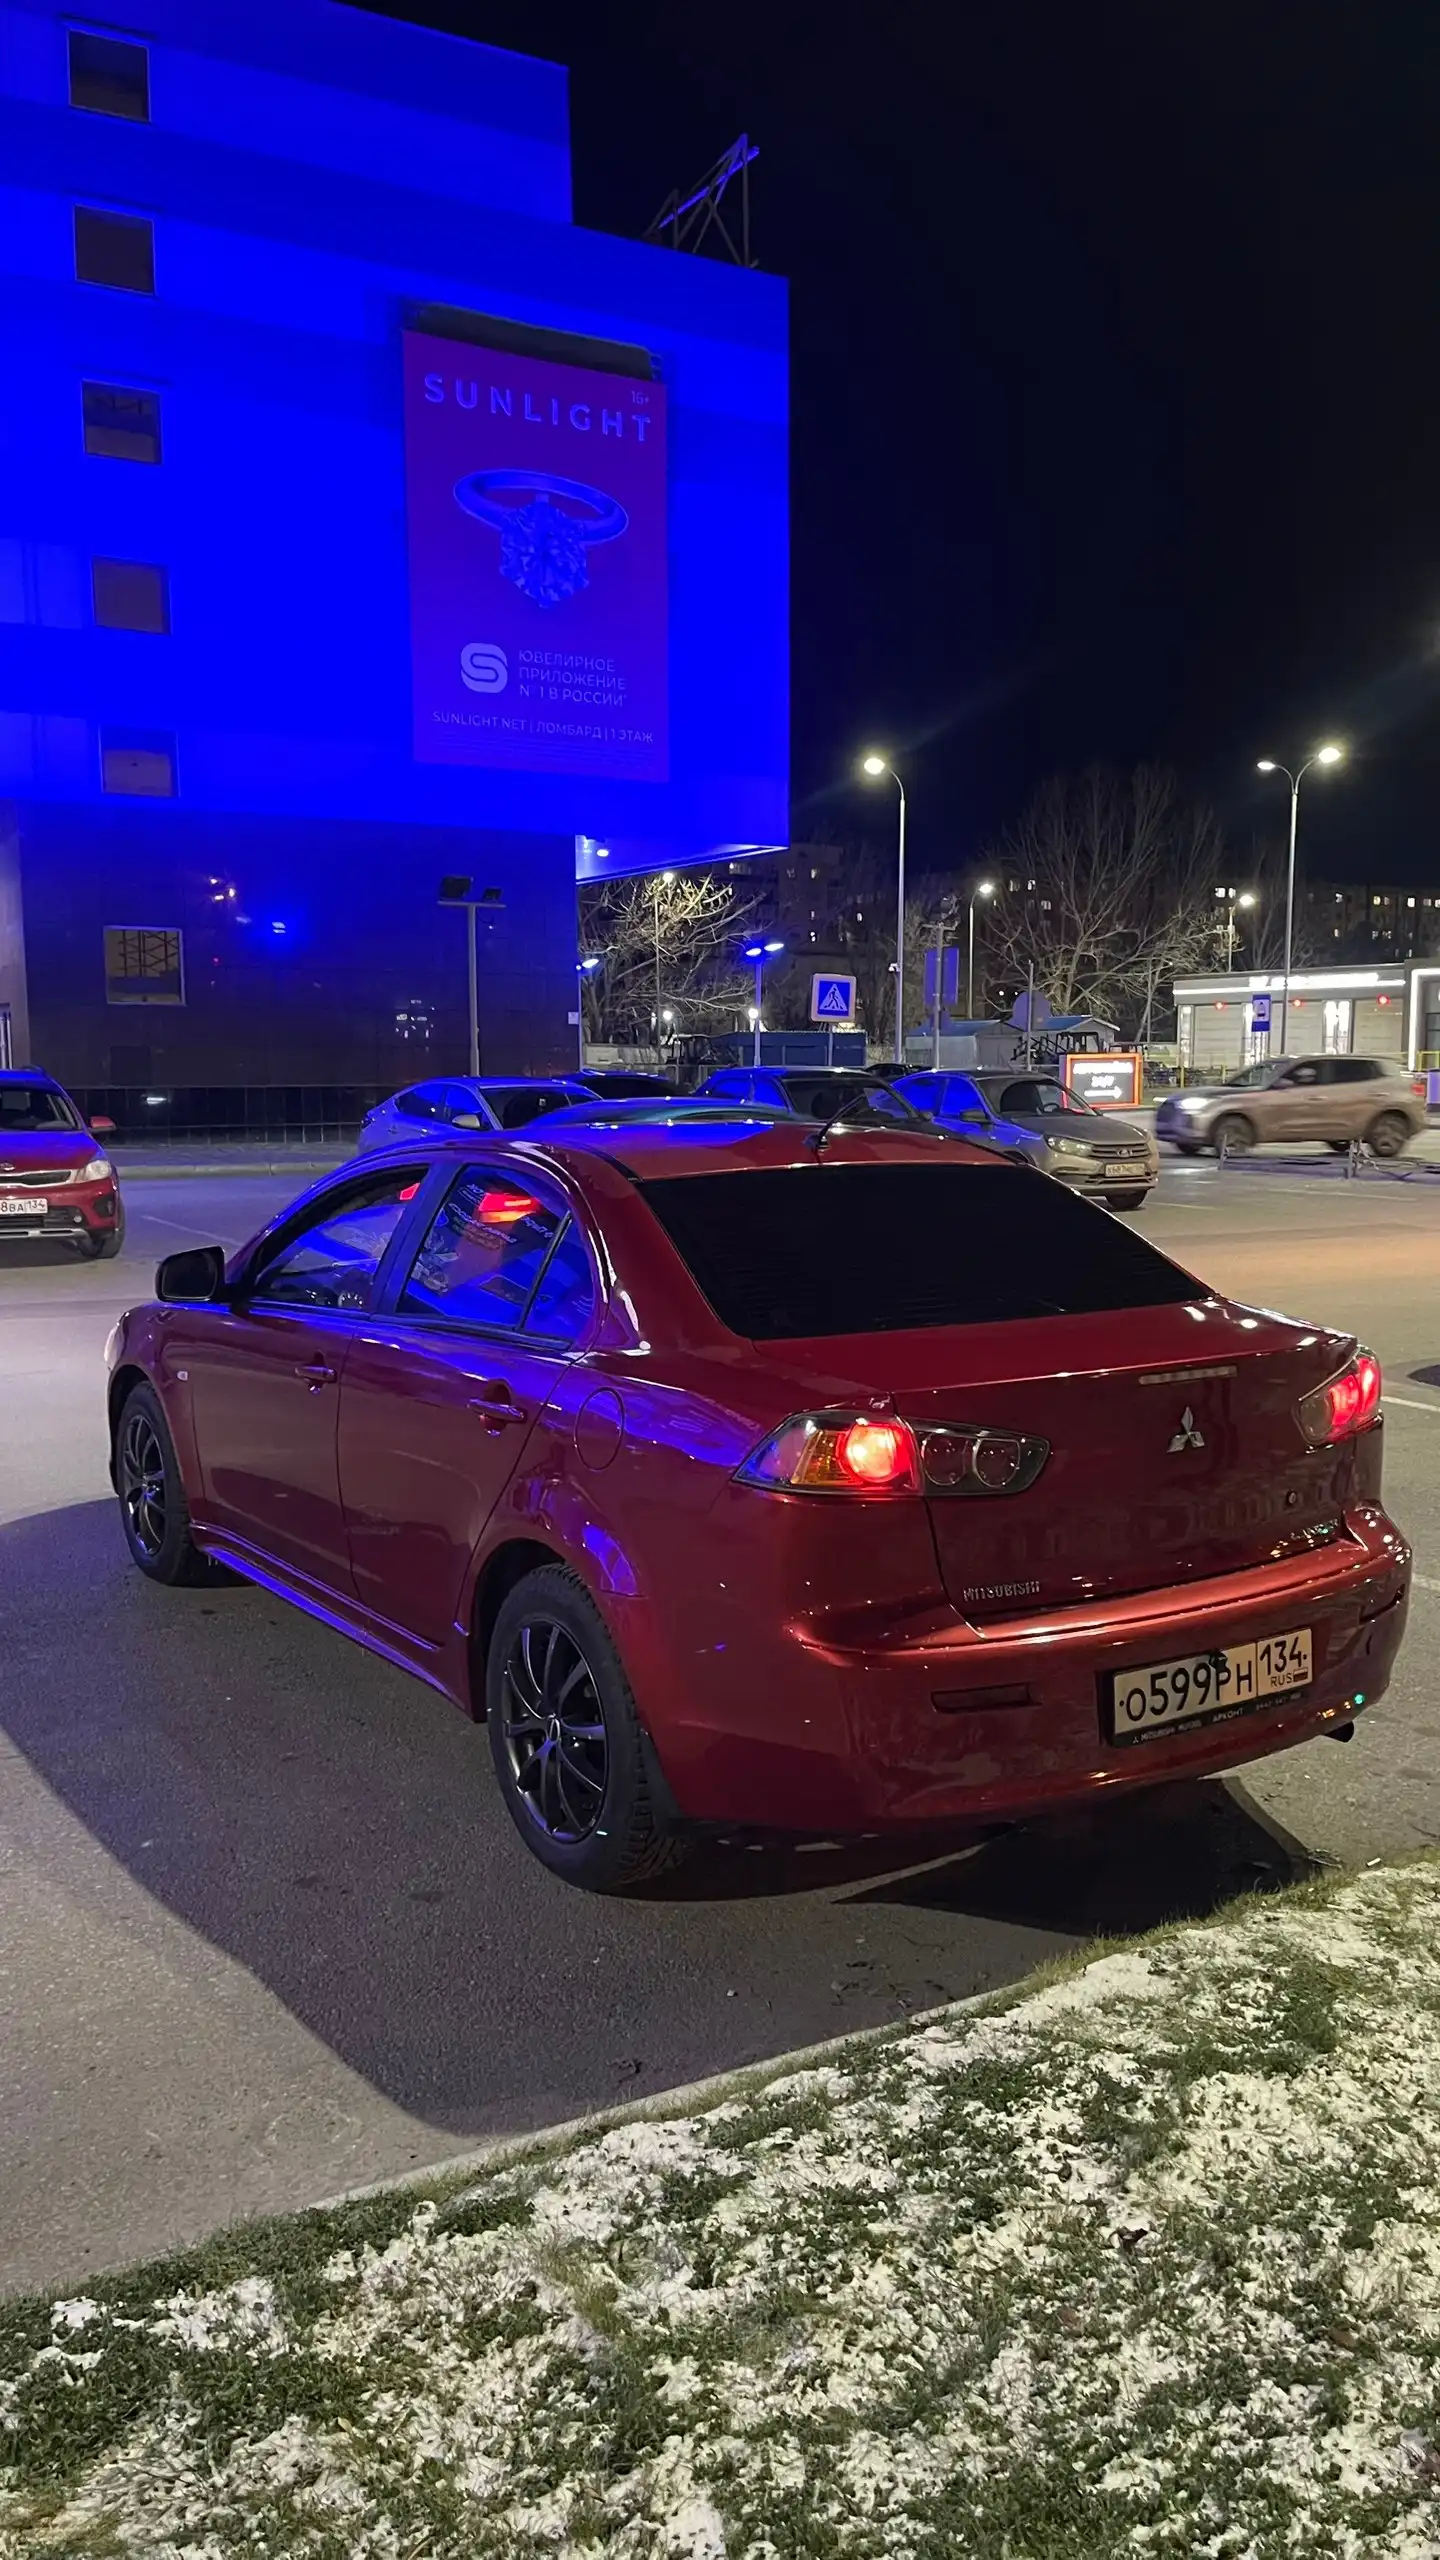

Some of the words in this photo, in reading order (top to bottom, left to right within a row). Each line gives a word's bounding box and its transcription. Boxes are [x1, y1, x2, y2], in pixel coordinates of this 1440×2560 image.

[424, 372, 651, 442] SUNLIGHT
[518, 649, 616, 673] ЮВЕЛИРНОЕ
[518, 667, 627, 690] ПРИЛОЖЕНИЕ
[536, 721, 602, 739] ЛОМБАРД
[618, 729, 654, 744] ЭТАЖ
[963, 1580, 1040, 1602] MITSUBISHI
[1259, 1636, 1302, 1676] 134
[1270, 1672, 1293, 1688] RUS
